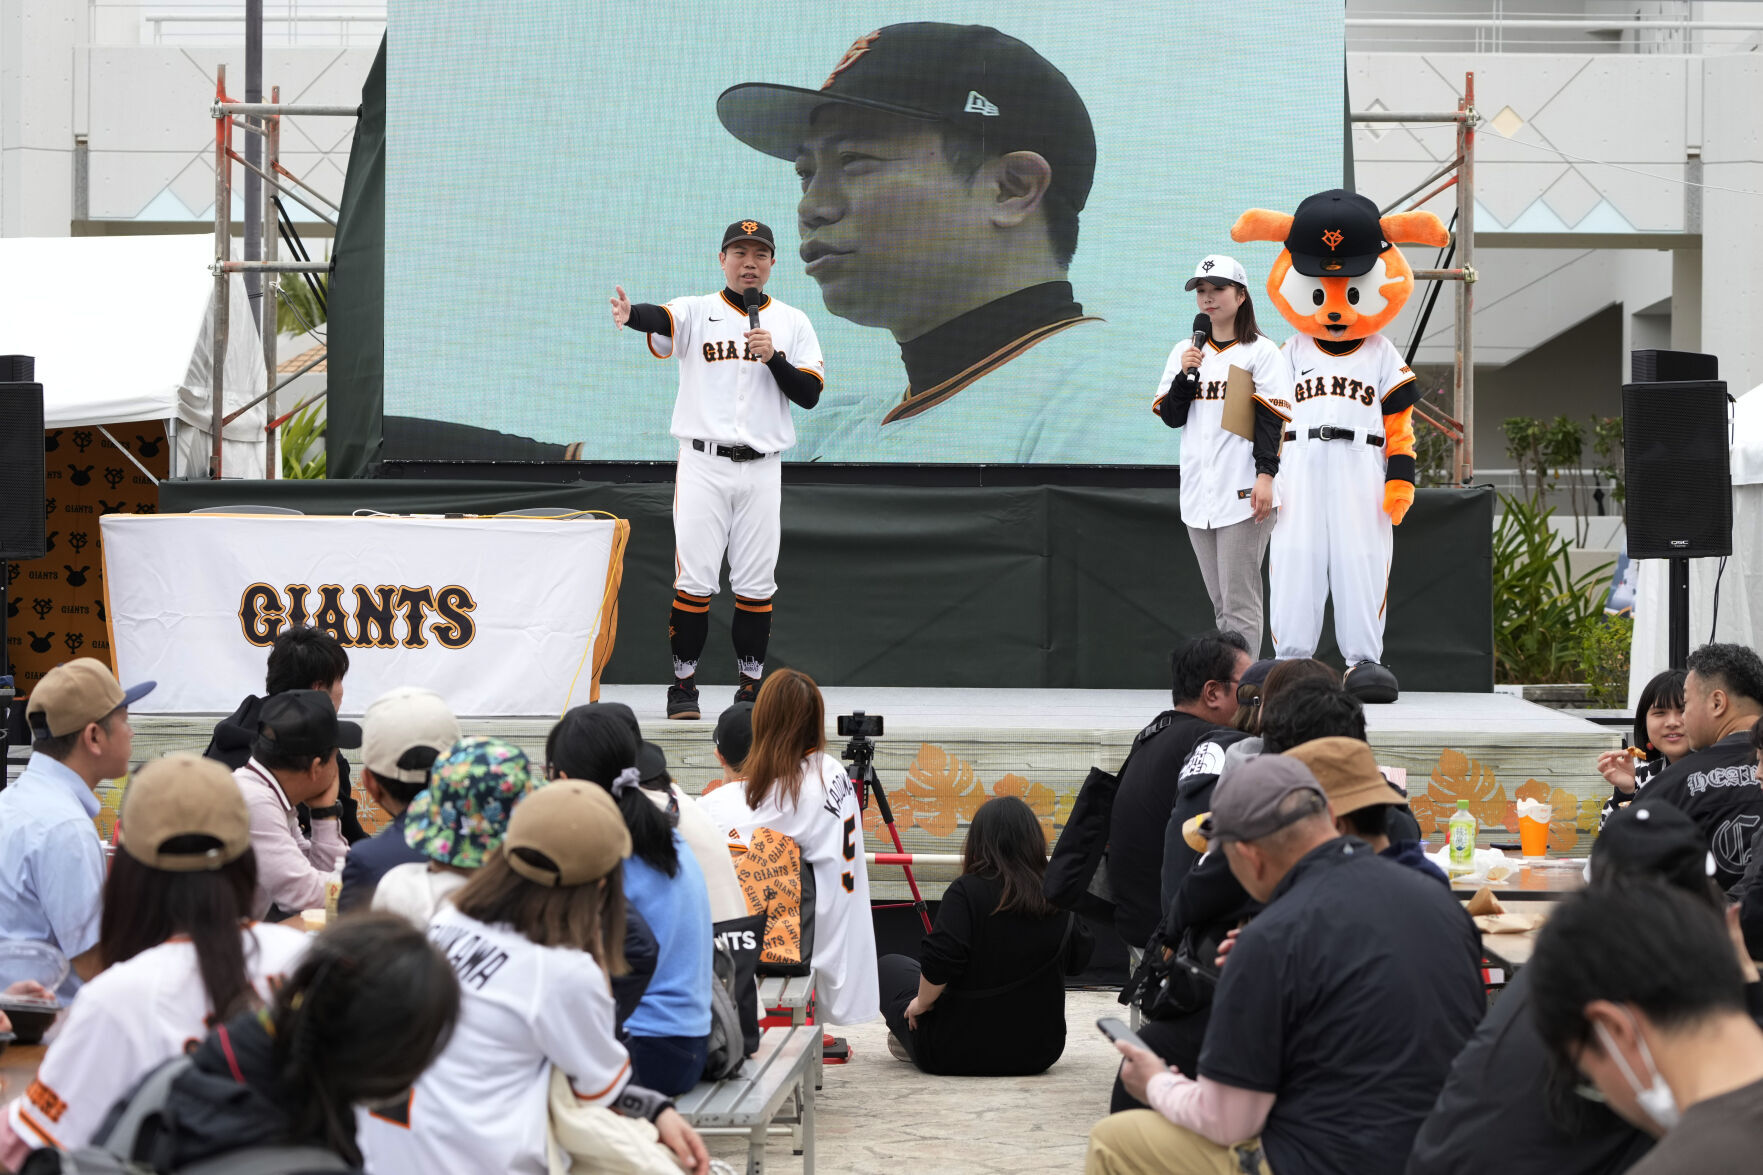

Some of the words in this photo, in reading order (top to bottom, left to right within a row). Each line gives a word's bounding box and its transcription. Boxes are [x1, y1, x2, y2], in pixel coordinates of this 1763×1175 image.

[1294, 376, 1375, 406] GIANTS
[28, 570, 58, 580] GIANTS
[61, 605, 90, 615] GIANTS
[239, 582, 477, 650] GIANTS
[753, 865, 789, 882] GIANTS
